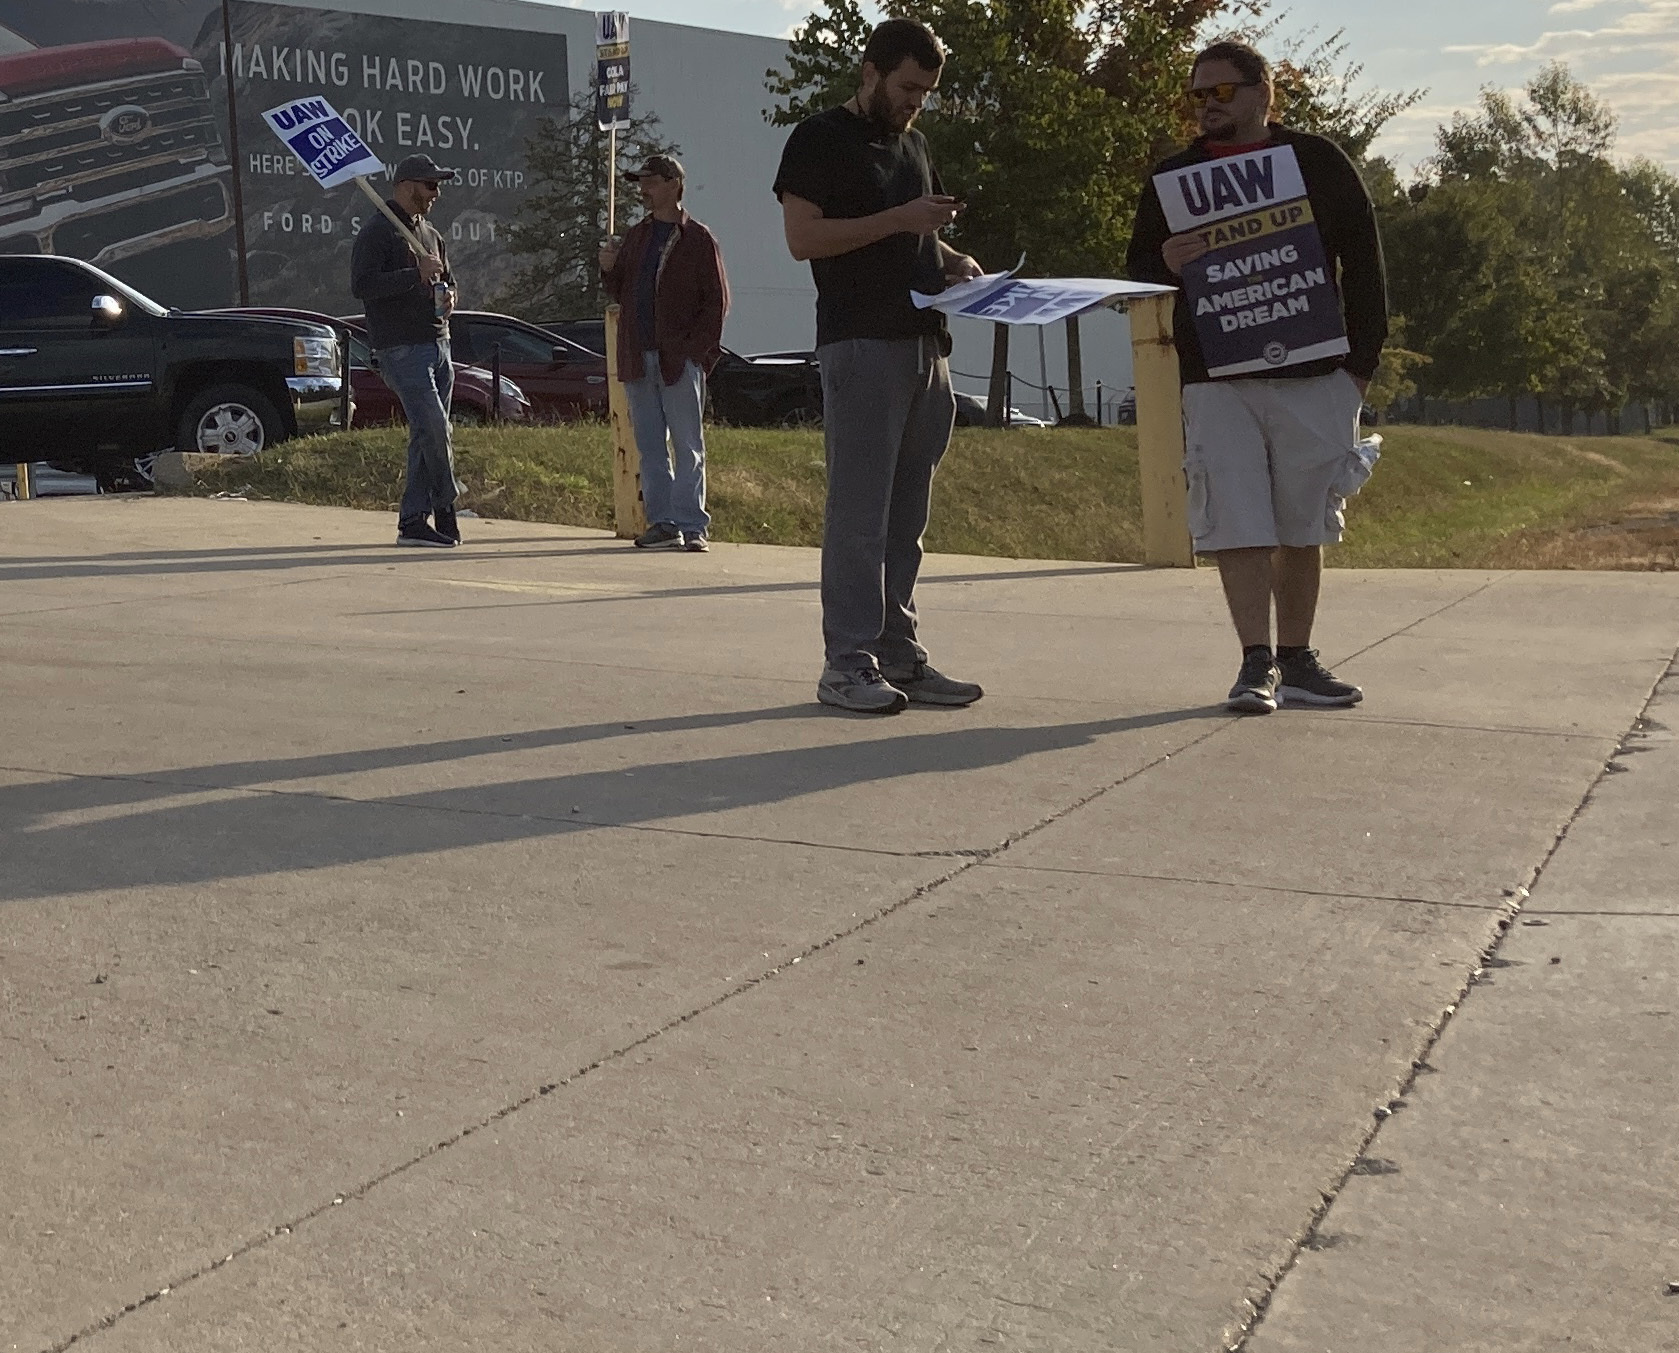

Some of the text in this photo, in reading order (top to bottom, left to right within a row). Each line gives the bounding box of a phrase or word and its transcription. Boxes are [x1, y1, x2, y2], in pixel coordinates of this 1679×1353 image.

[220, 41, 546, 103] MAKING HARD WORK
[271, 100, 329, 130] UAW
[342, 108, 479, 150] OK EASY.
[308, 124, 335, 150] ON
[310, 132, 362, 178] STRIKE
[468, 168, 490, 187] OF
[494, 170, 528, 190] KTP.
[1178, 154, 1275, 217] UAW
[263, 211, 332, 234] FORD
[452, 222, 497, 242] DUT
[1198, 206, 1303, 248] TAND UP
[1205, 244, 1299, 283] SAVING
[1196, 267, 1326, 316] AMERICAN
[1220, 295, 1310, 333] DREAM
